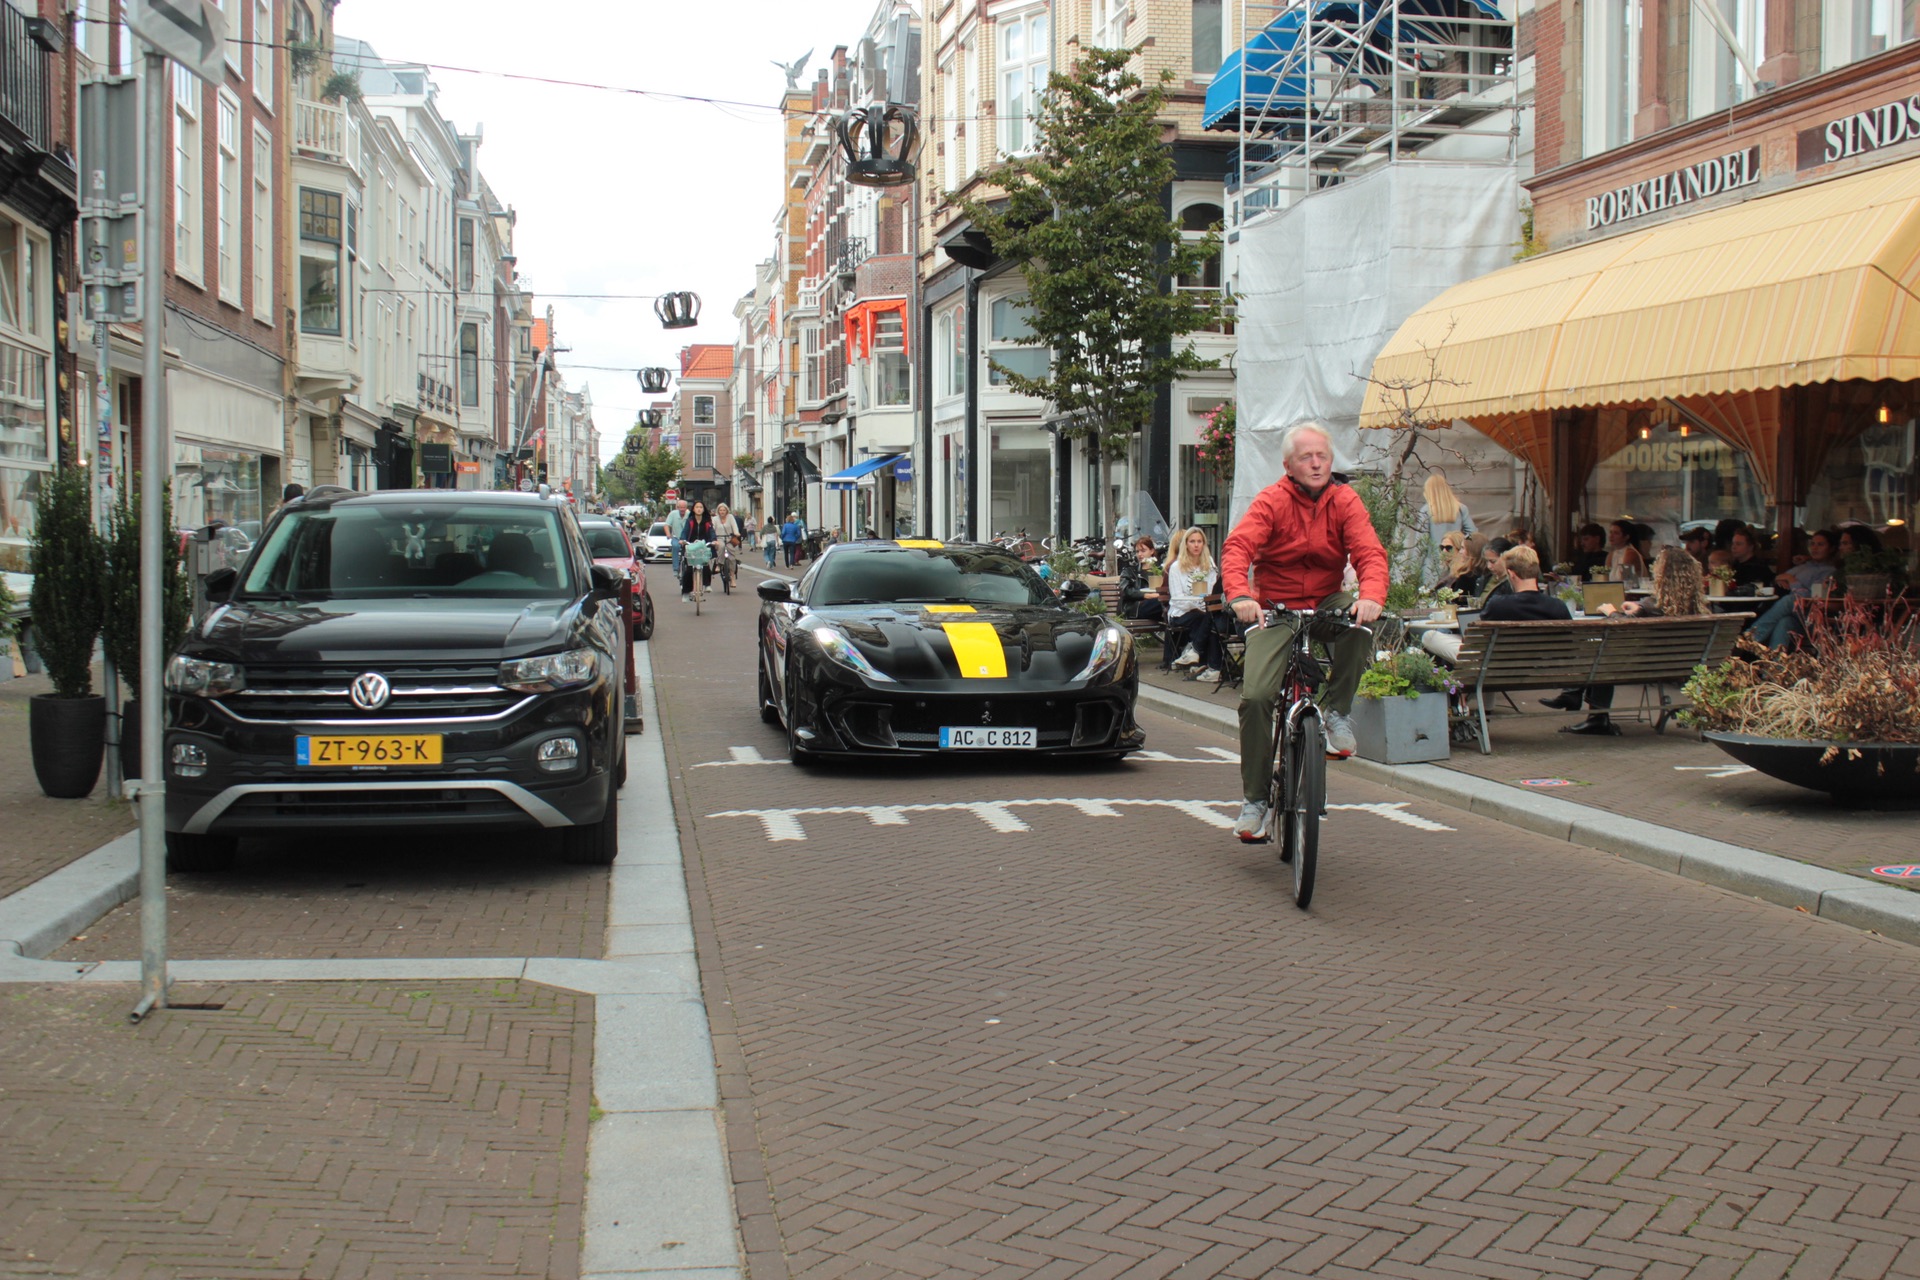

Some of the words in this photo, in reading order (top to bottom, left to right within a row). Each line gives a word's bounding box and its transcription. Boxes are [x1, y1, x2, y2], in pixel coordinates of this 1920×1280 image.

[1824, 95, 1920, 163] SINDS
[1585, 147, 1761, 231] BOEKHANDEL
[318, 739, 429, 761] ZT-963-K
[953, 730, 974, 746] AC
[987, 731, 997, 746] C
[1002, 731, 1031, 746] 812
